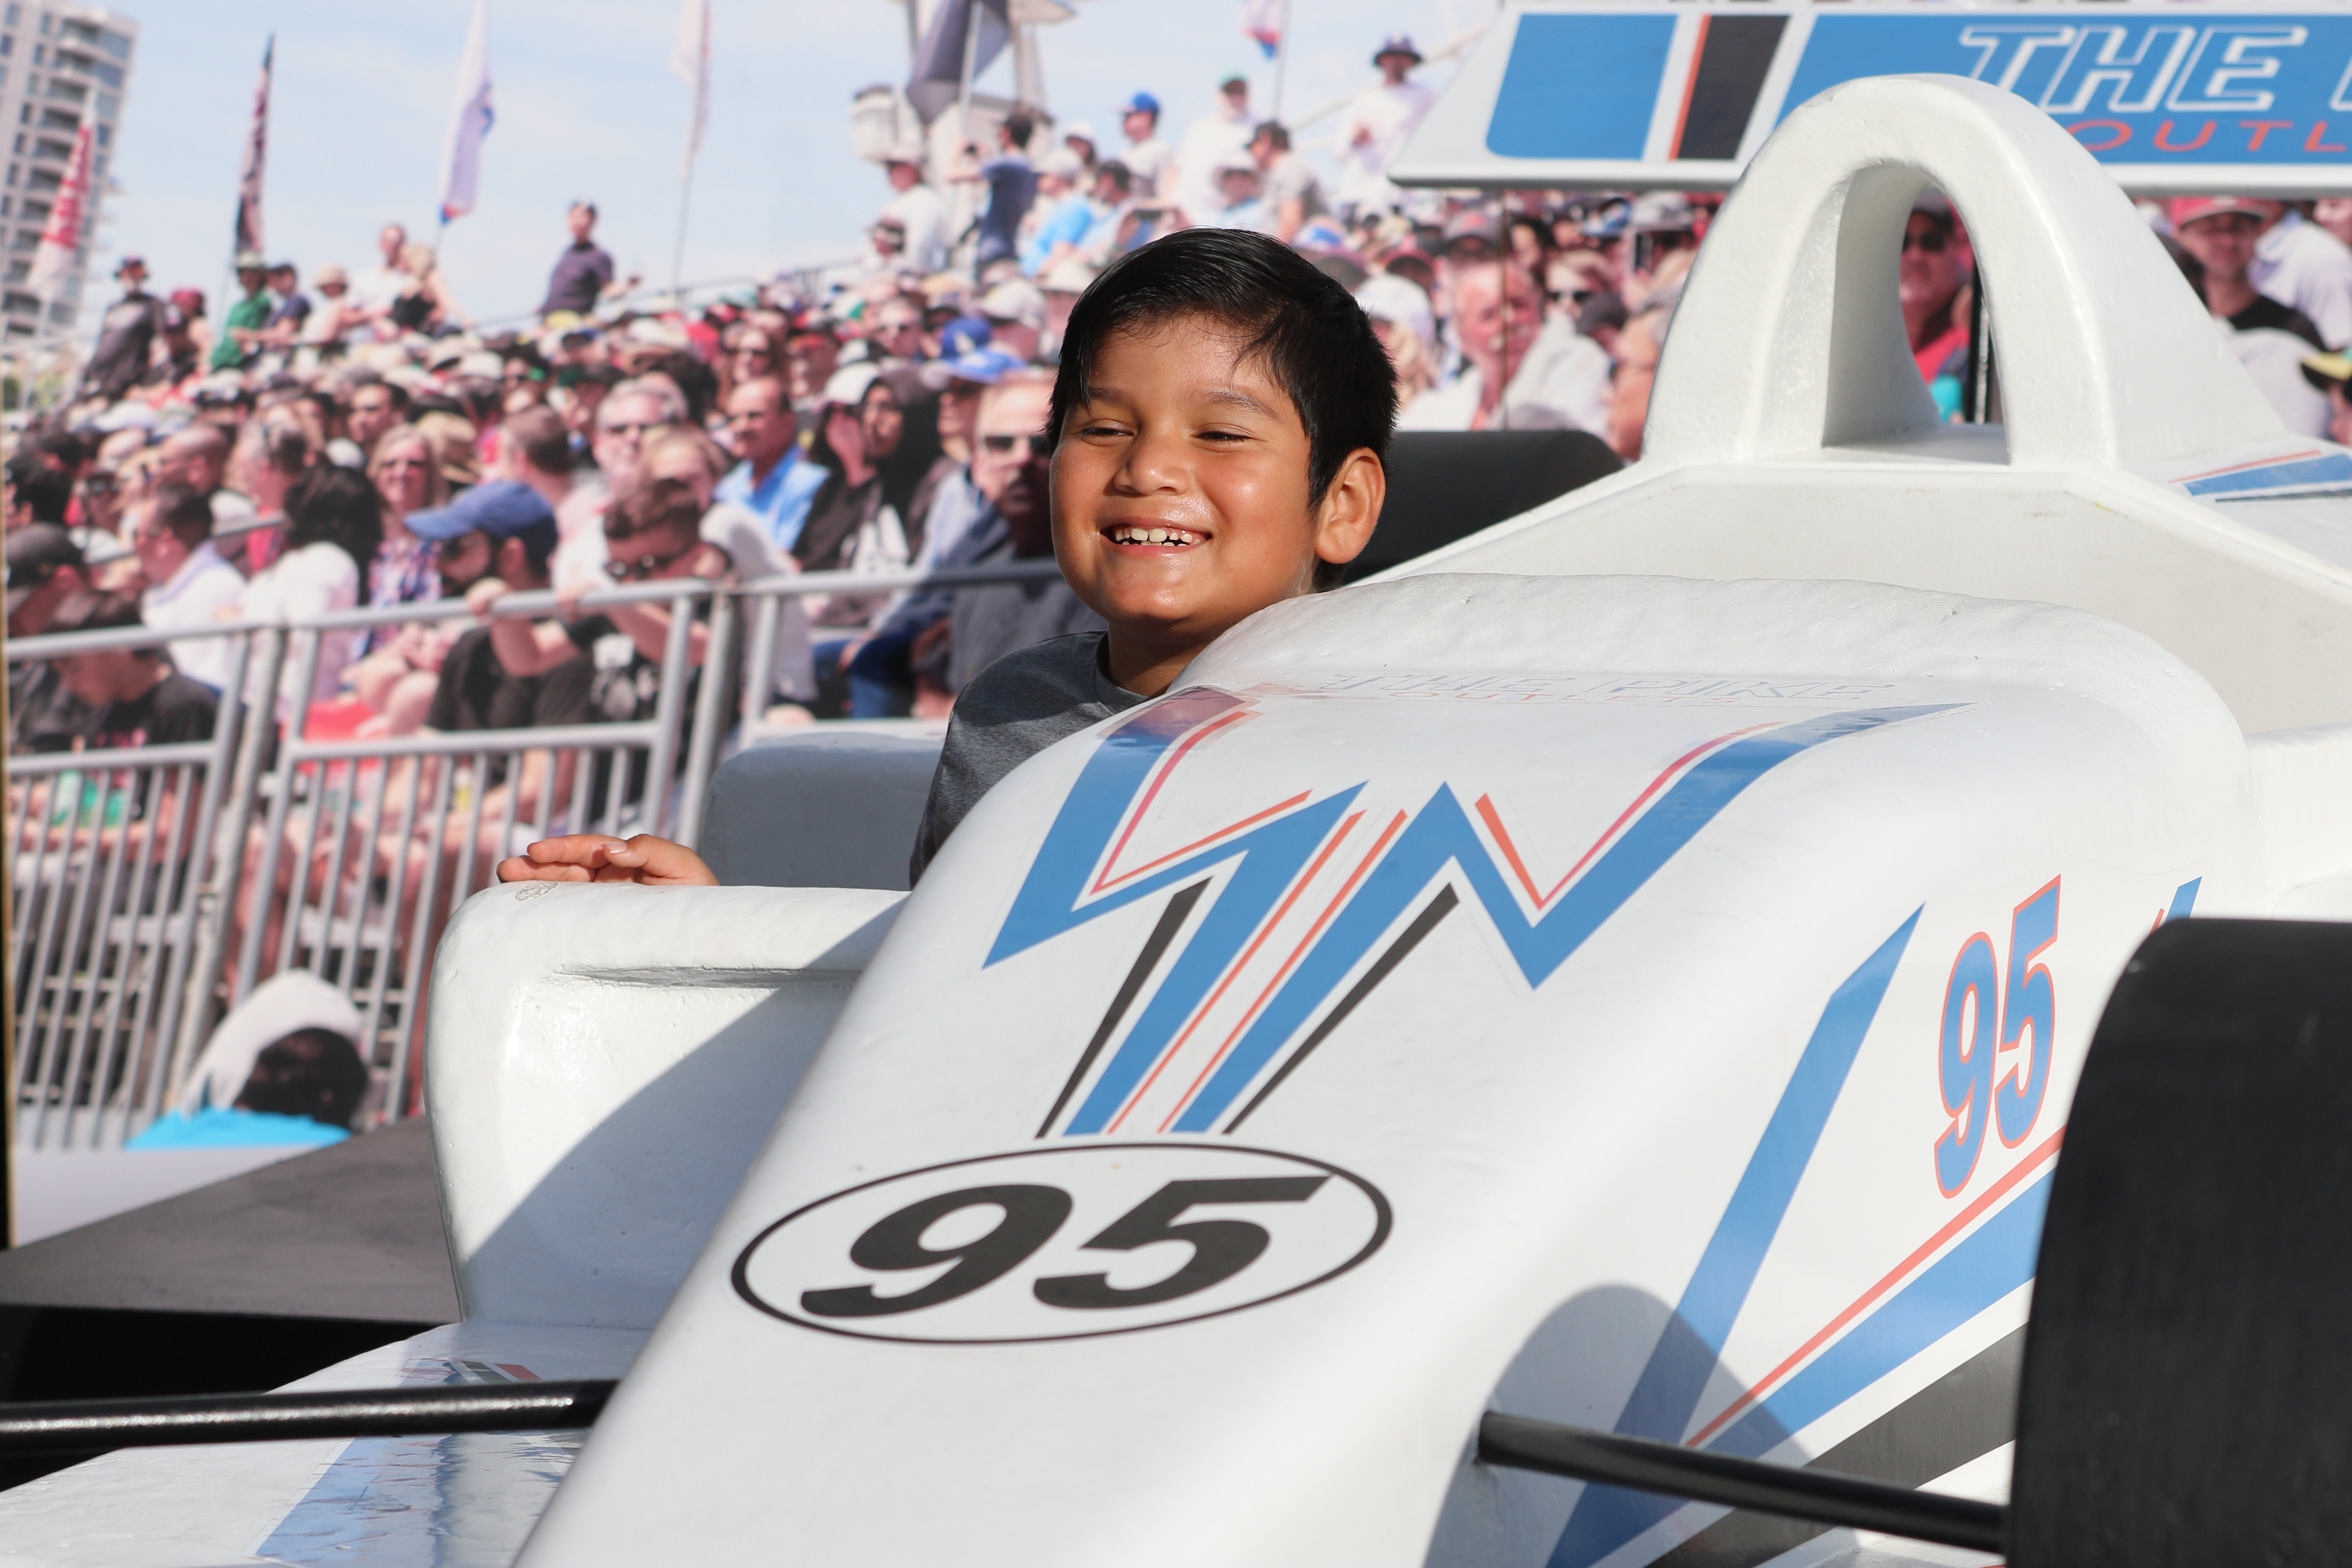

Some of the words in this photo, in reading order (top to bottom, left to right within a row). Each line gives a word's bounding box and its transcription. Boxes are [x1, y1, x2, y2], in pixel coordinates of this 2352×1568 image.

[1959, 25, 2309, 113] THE
[1318, 673, 1577, 692] THE
[1583, 678, 1896, 700] PIKE
[1388, 691, 1741, 704] OUTLETS
[1934, 873, 2062, 1199] 95
[800, 1175, 1333, 1317] 95
